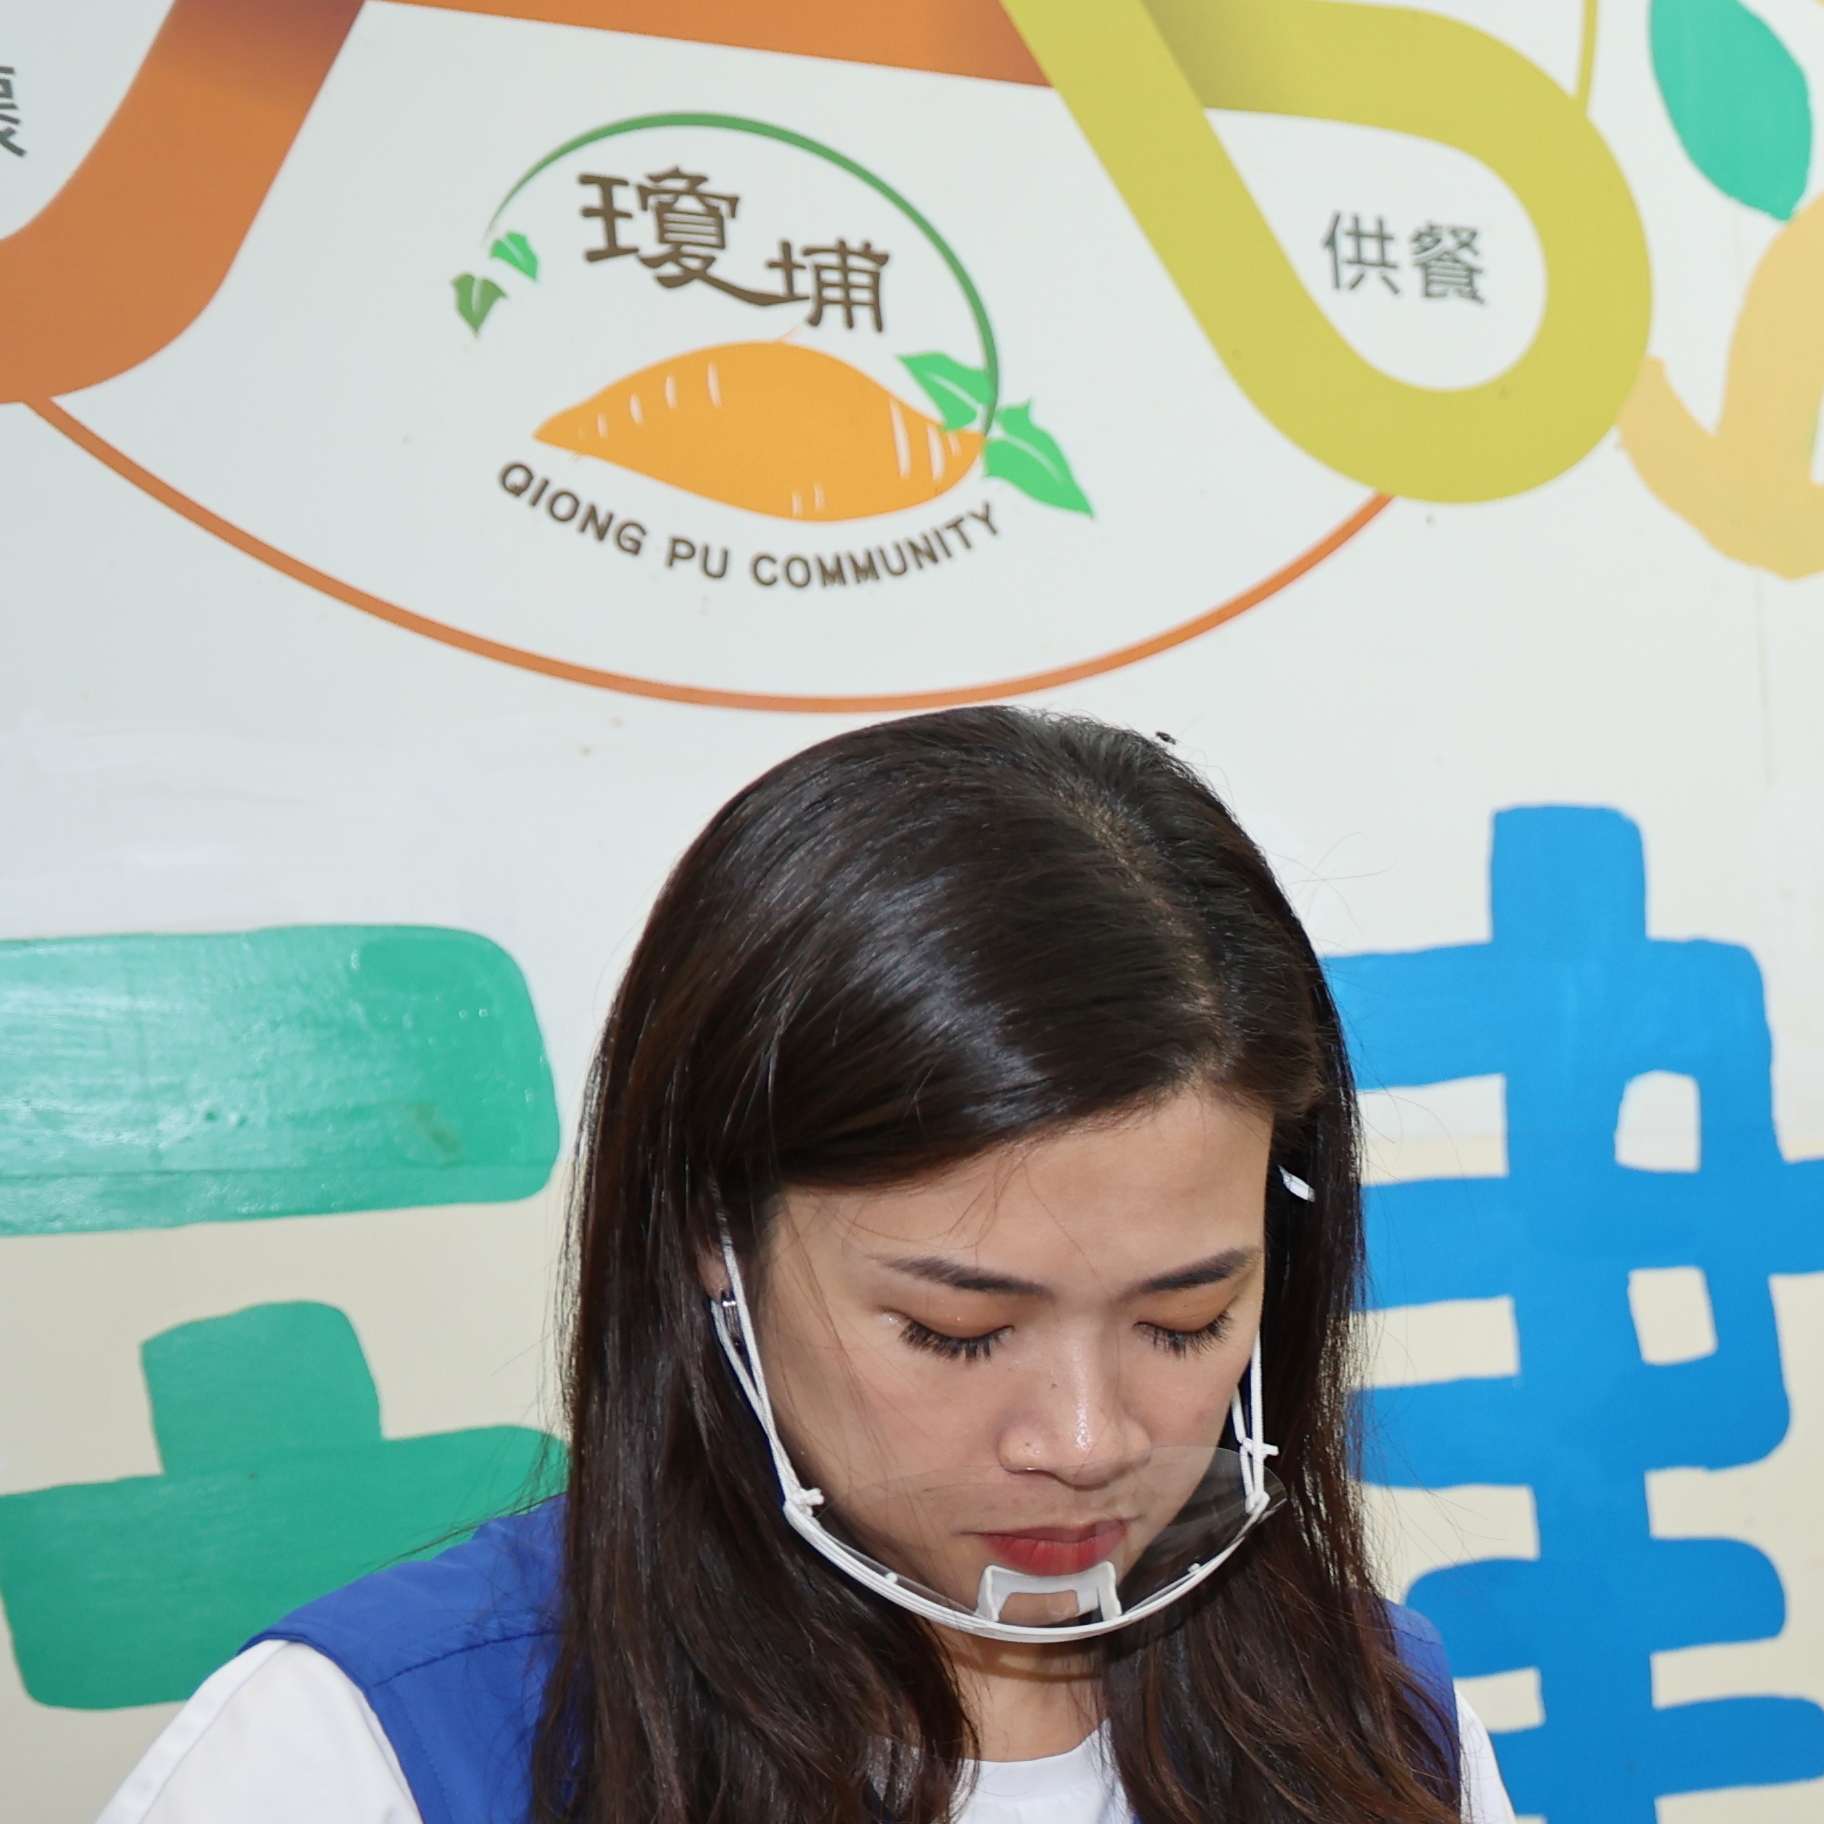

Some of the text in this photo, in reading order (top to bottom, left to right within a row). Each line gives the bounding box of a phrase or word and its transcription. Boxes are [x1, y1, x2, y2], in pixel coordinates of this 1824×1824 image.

[576, 165, 891, 334] 瓊埔
[1323, 208, 1486, 305] 供餐
[498, 461, 1001, 590] QIONG PU COMMUNITY
